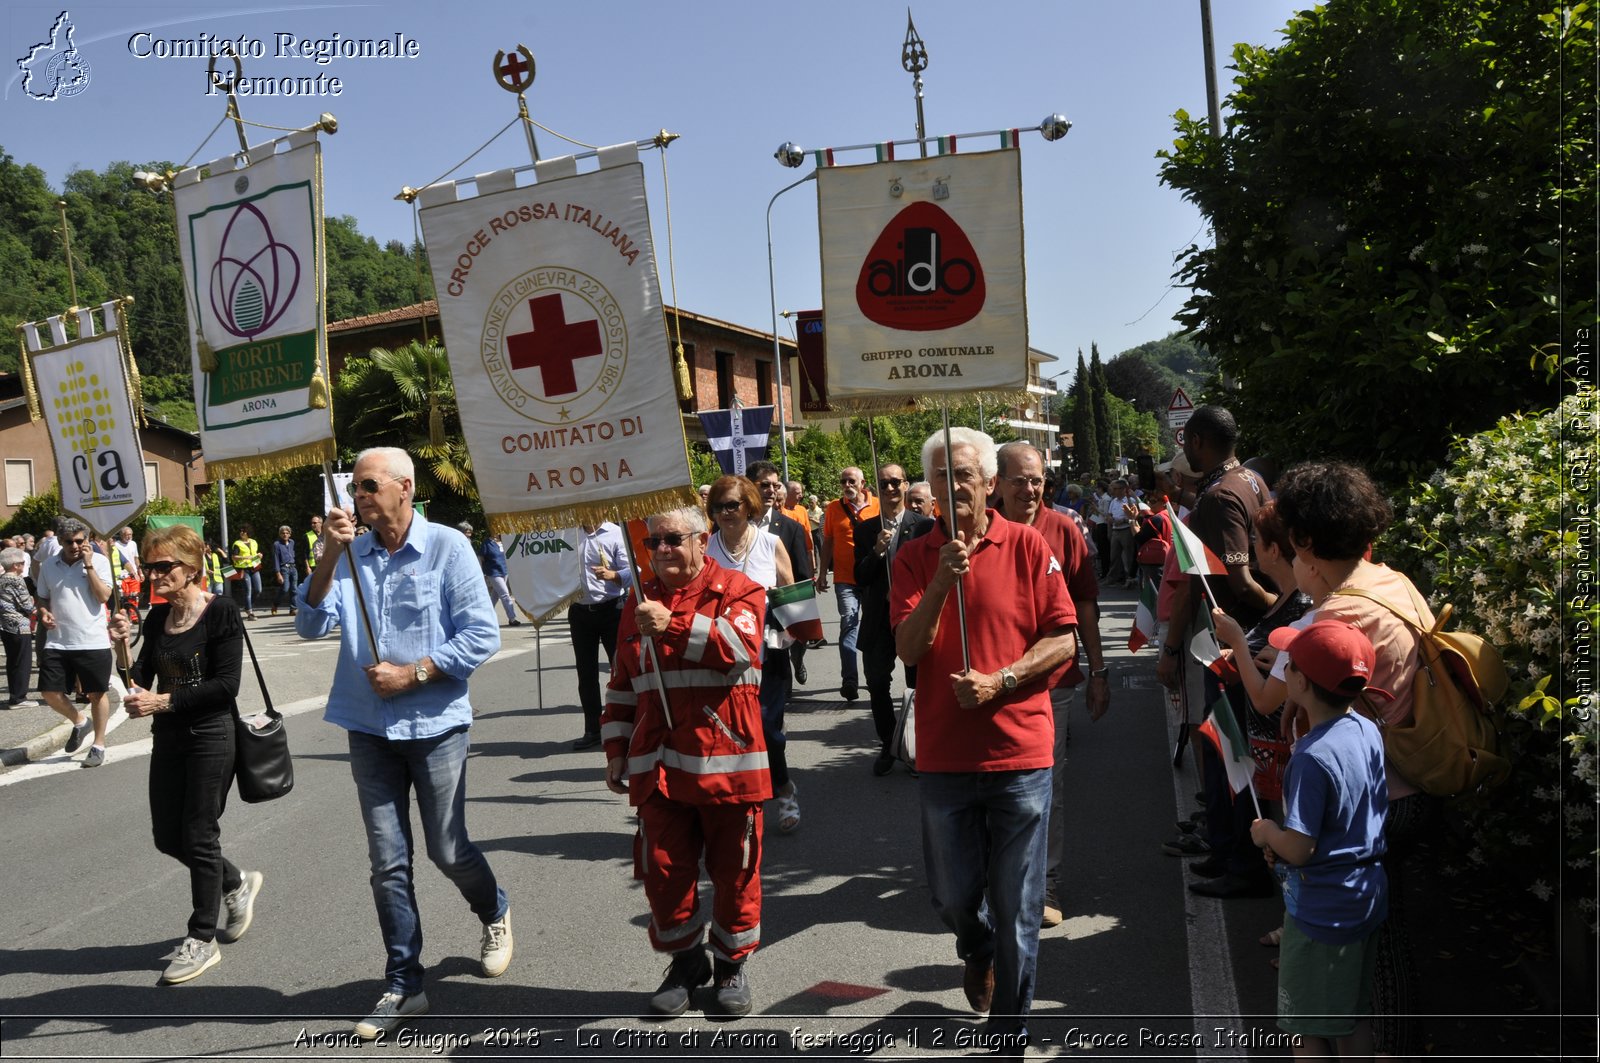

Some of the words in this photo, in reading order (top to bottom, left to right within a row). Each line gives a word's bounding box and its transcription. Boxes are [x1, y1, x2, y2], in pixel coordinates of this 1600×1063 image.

[447, 229, 491, 298] CROCE
[488, 202, 560, 236] ROSSA
[564, 204, 641, 266] ITALIANA
[514, 271, 577, 296] GINEVRA
[579, 280, 599, 299] 22
[500, 294, 515, 307] DI
[597, 295, 624, 360] AGOSTO
[229, 342, 284, 370] FORTI
[484, 305, 527, 408] CONVENZIONE
[861, 349, 913, 362] GRUPPO
[918, 346, 994, 359] COMUNALE
[232, 362, 304, 392] SERENE
[598, 364, 619, 394] 1864
[888, 363, 963, 380] ARONA
[242, 399, 277, 413] ARONA
[501, 421, 615, 455] COMITATO
[620, 415, 644, 437] DI
[527, 458, 633, 492] ARONA
[527, 530, 555, 541] LOCO
